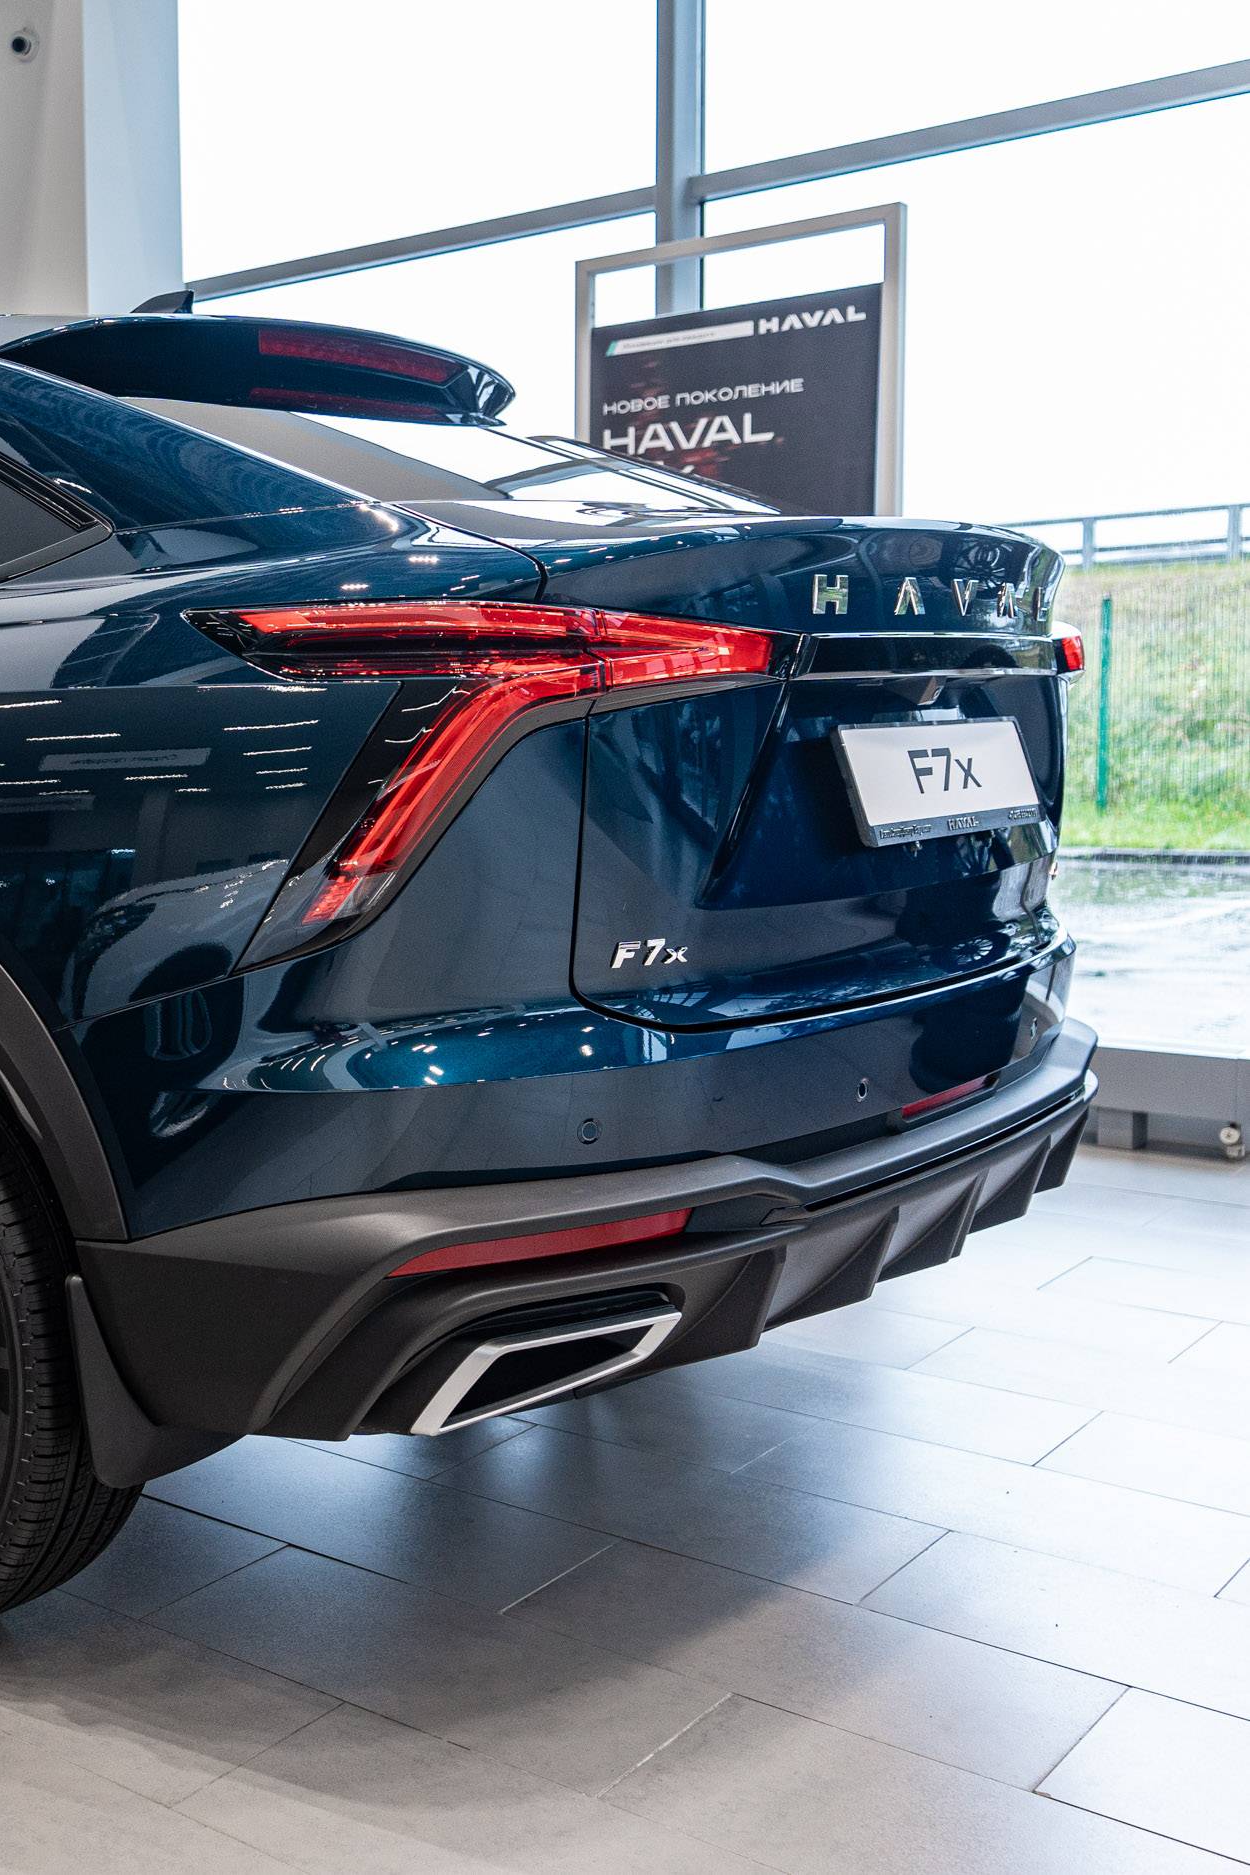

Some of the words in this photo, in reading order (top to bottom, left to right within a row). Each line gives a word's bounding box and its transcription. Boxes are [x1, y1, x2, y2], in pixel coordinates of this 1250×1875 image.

[757, 305, 867, 335] HAVAL
[602, 394, 671, 416] НОВОЕ
[675, 378, 805, 408] ПОКОЛЕНИЕ
[602, 412, 776, 456] HAVAL
[812, 574, 1052, 622] HAVAL
[907, 747, 983, 794] F7x
[947, 815, 980, 831] HAVAL
[610, 938, 688, 969] F7x
